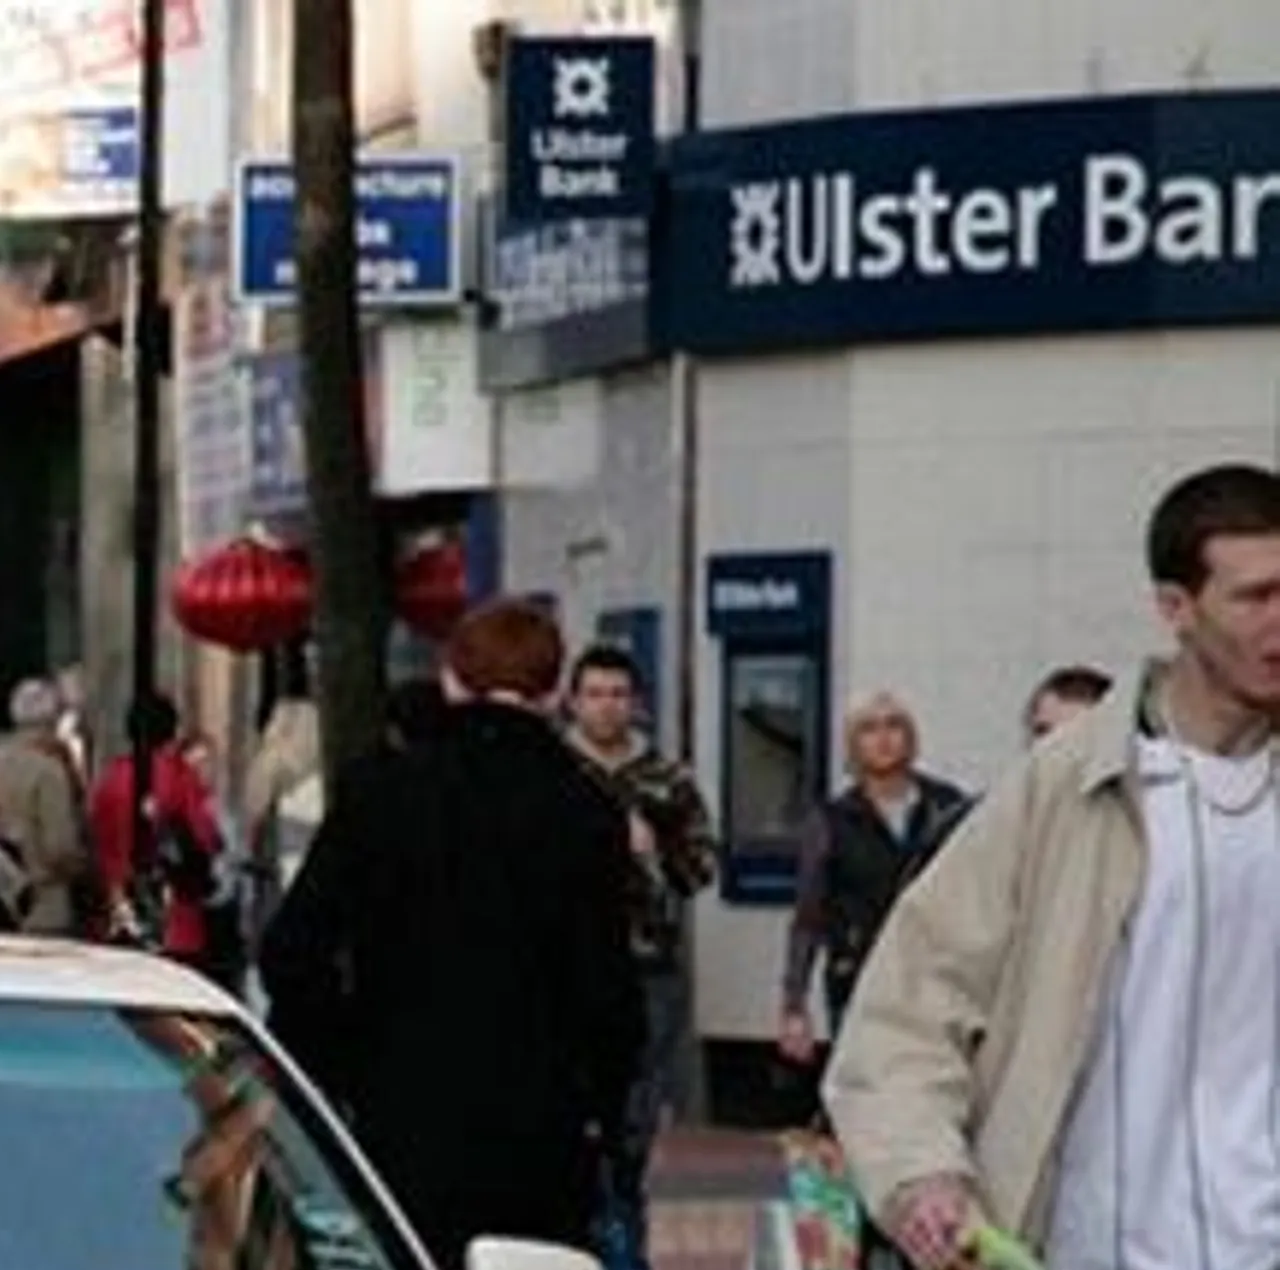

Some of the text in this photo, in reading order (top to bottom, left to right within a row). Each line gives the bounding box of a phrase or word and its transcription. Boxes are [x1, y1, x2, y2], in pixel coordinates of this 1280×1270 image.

[530, 128, 627, 160] Ulster
[541, 162, 620, 197] Bank
[784, 165, 1057, 283] Ulster
